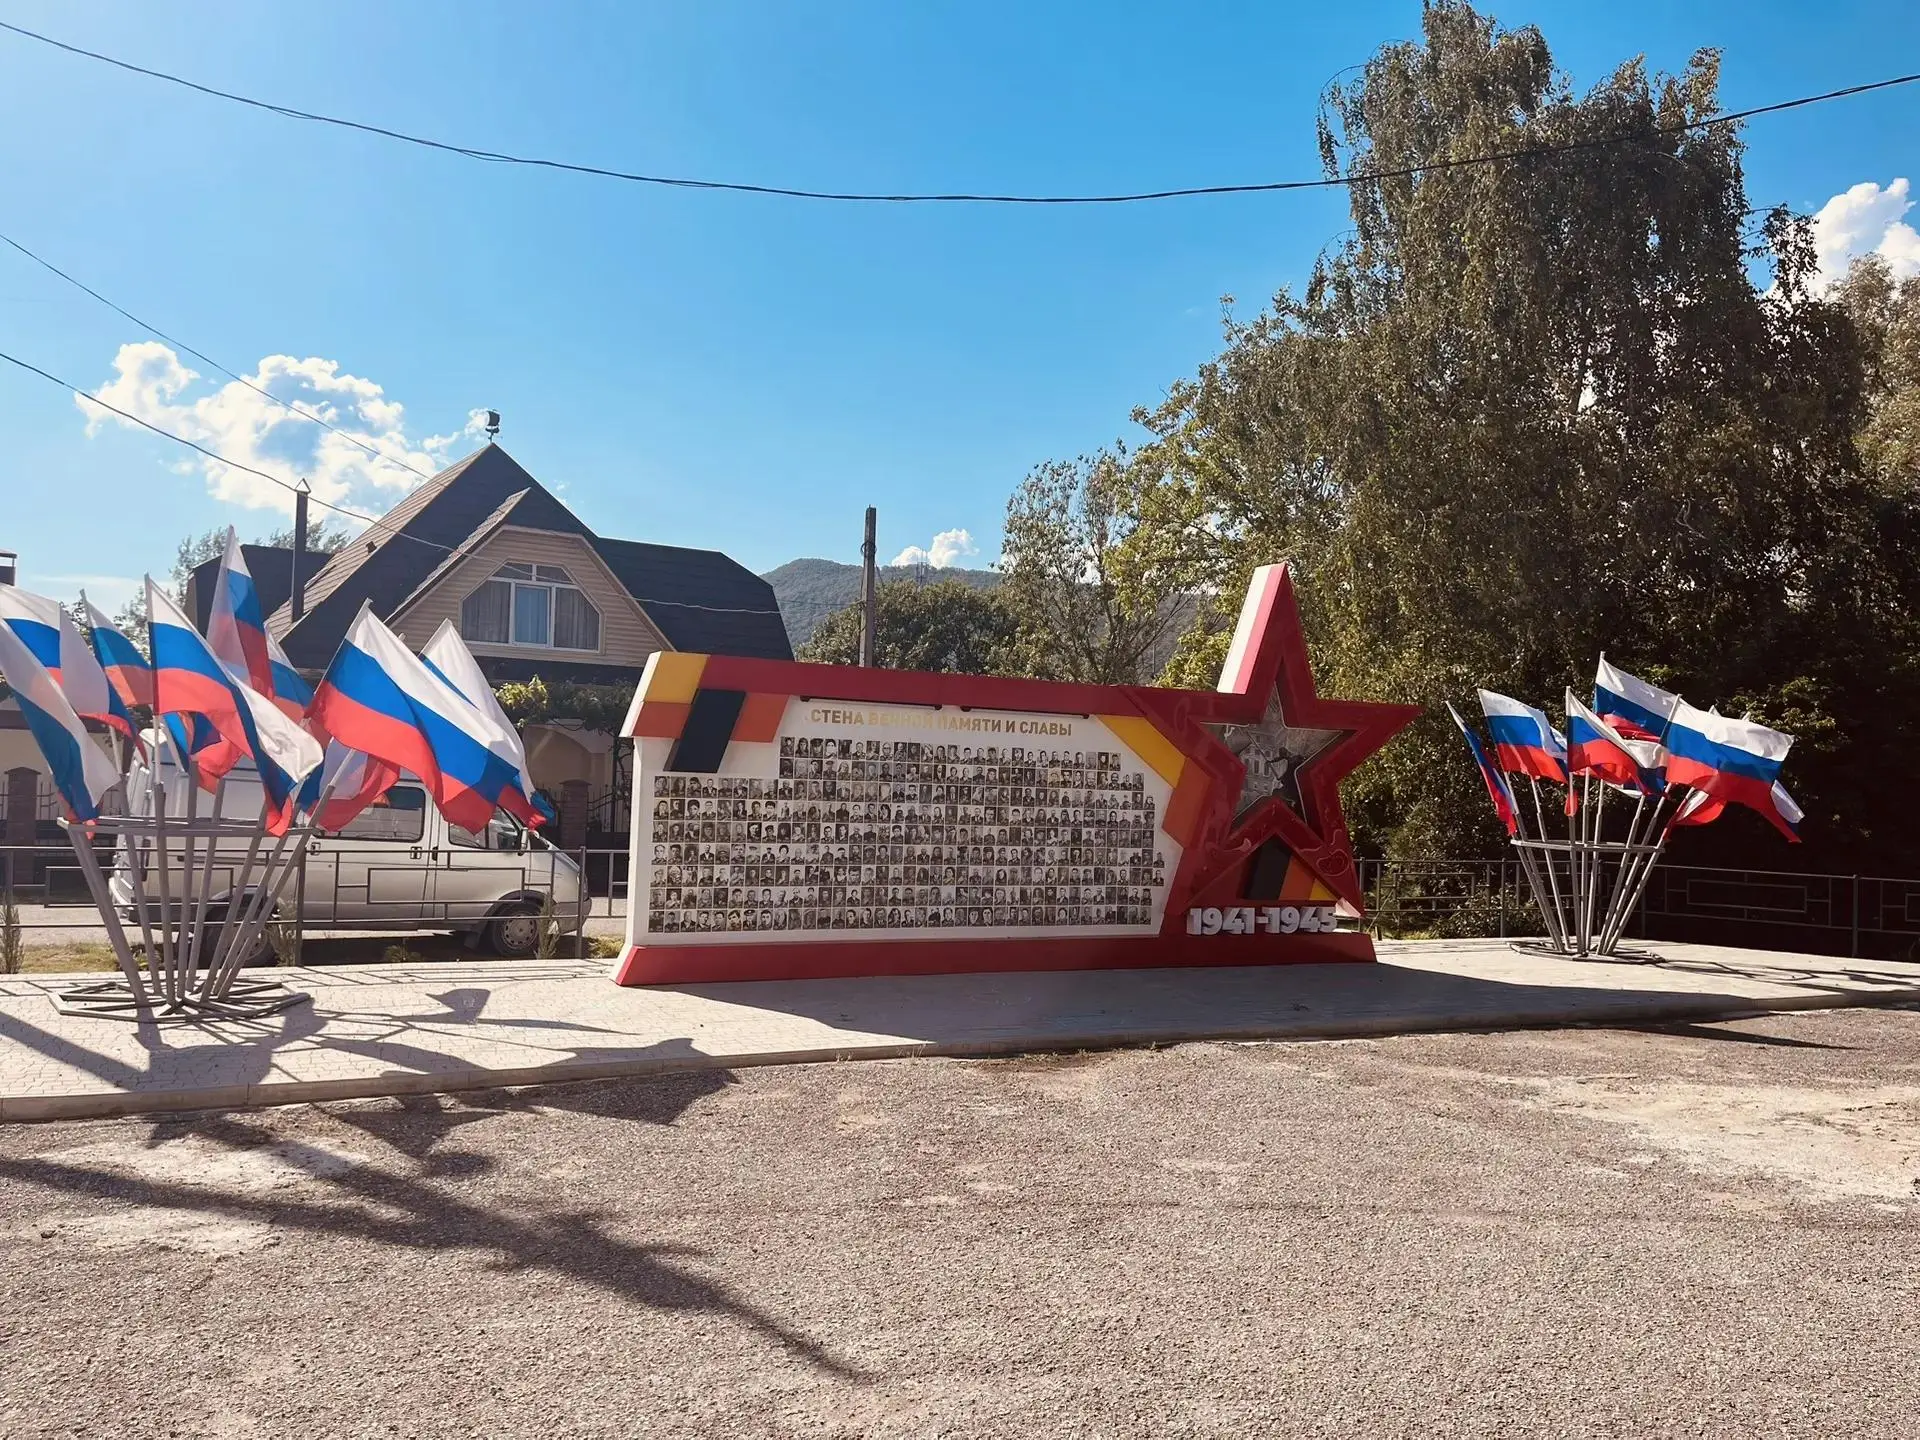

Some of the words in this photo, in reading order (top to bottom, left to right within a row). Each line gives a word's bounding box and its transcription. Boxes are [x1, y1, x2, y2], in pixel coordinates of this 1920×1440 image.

[810, 708, 865, 725] СТЕНА
[941, 716, 1003, 733] ПАМЯТИ
[1006, 719, 1016, 734] И
[1019, 720, 1072, 736] СЛАВЫ
[1186, 906, 1338, 935] 1941-1945
